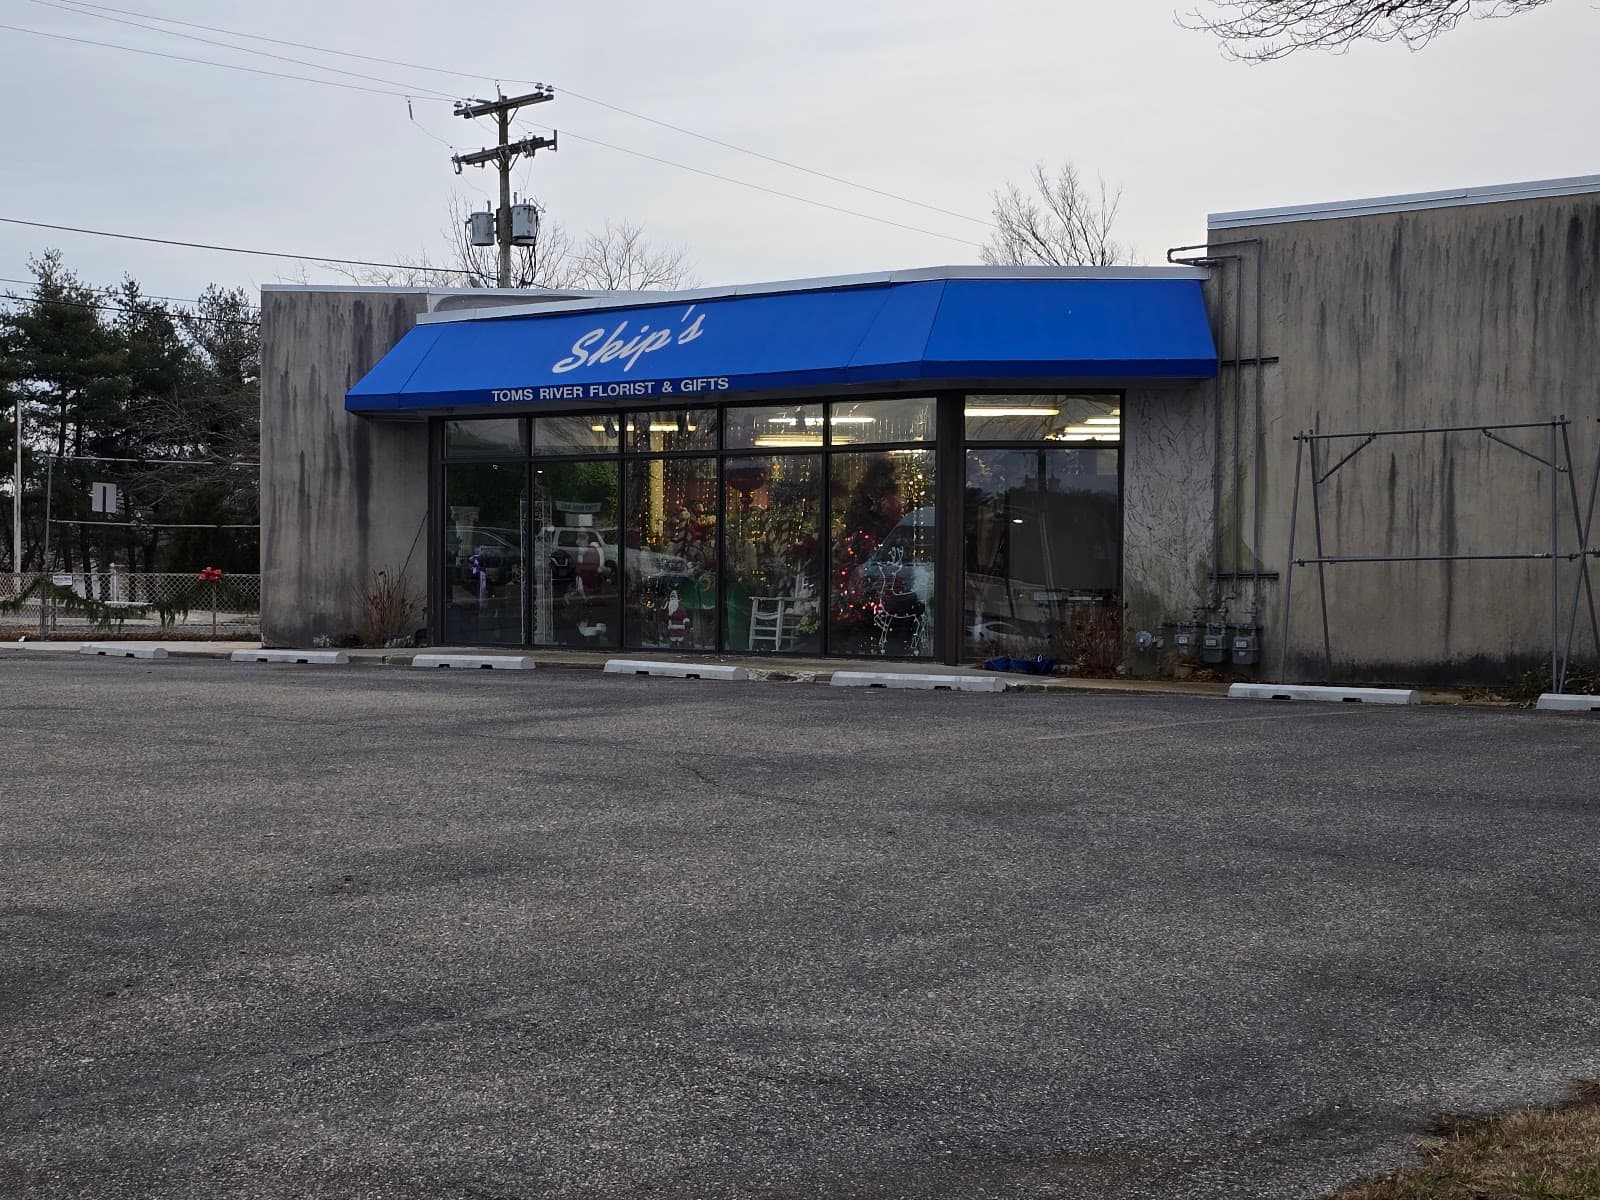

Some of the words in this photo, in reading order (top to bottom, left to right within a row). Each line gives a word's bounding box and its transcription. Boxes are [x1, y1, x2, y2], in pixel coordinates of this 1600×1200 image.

[552, 304, 706, 373] Skip's
[492, 389, 533, 402] TOMS
[539, 386, 583, 400] RIVER
[590, 382, 655, 398] FLORIST
[662, 381, 673, 393] &
[680, 378, 729, 392] GIFTS
